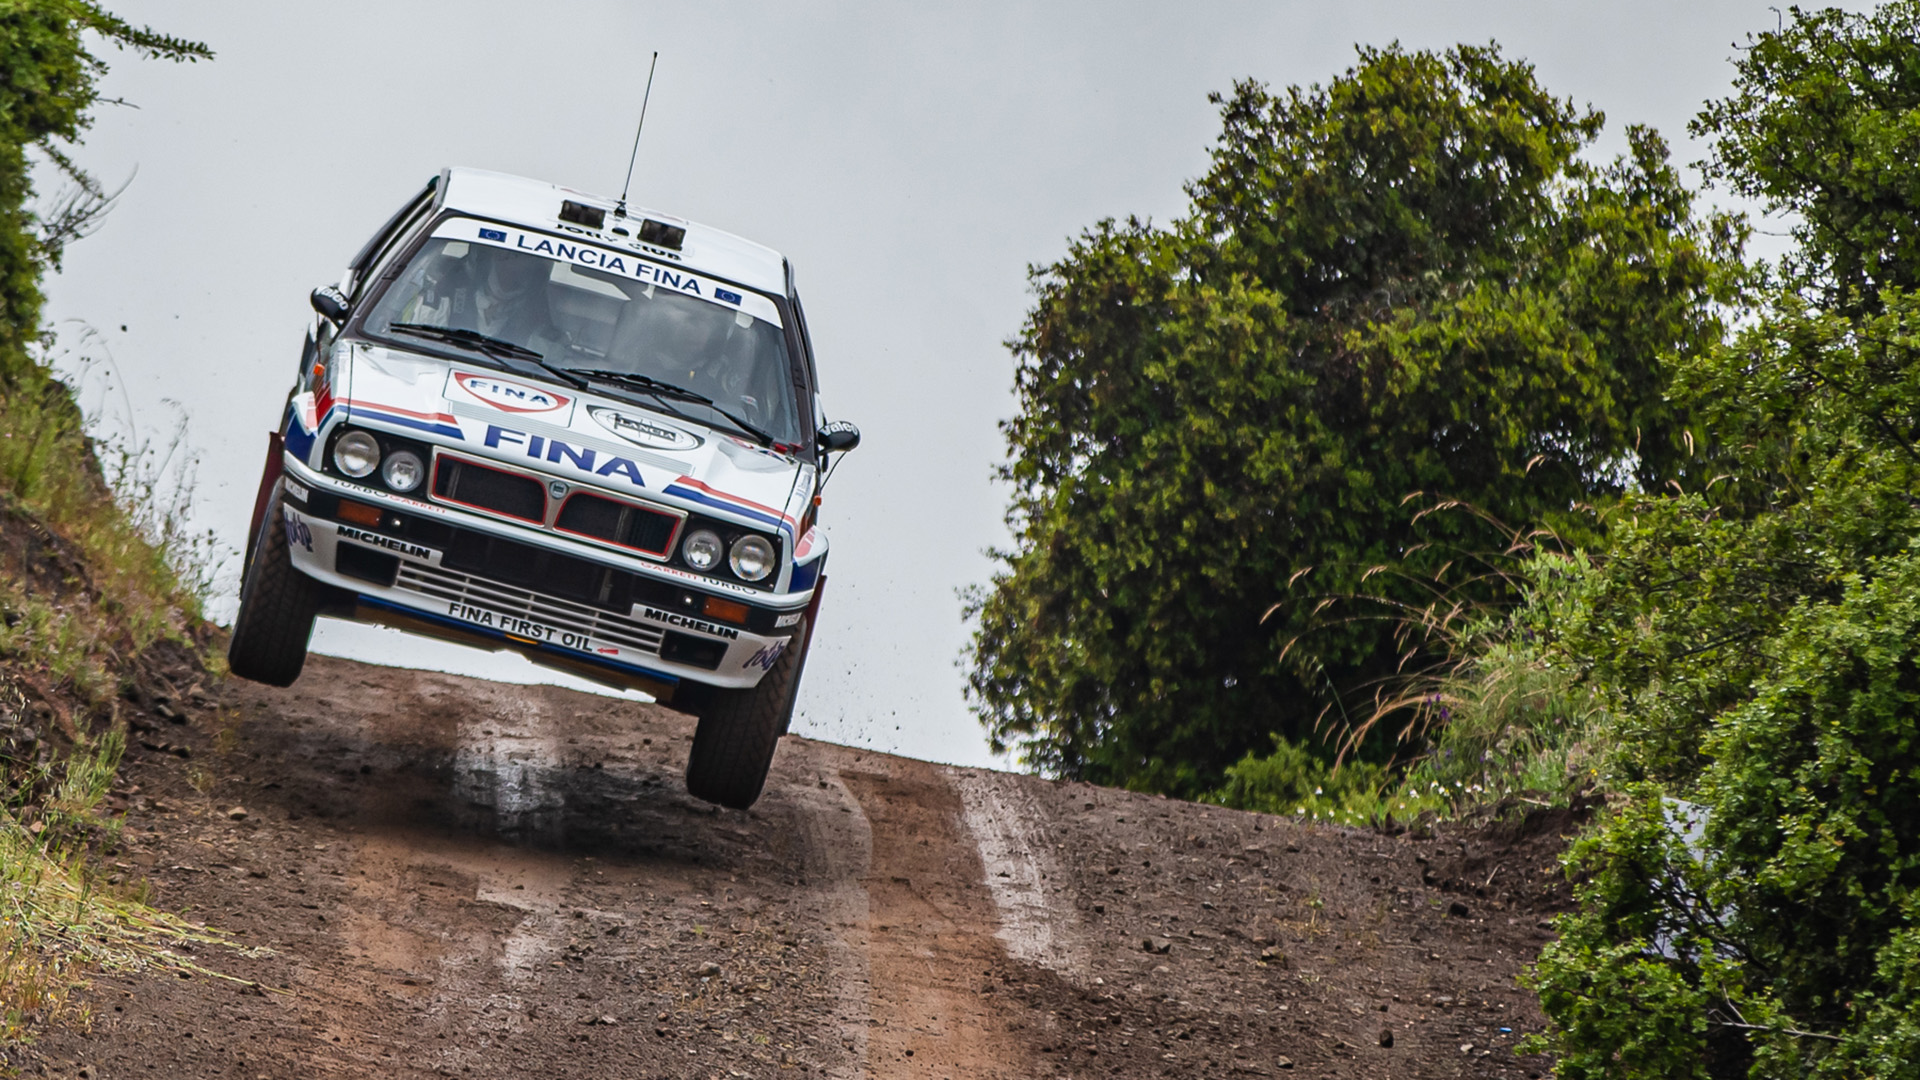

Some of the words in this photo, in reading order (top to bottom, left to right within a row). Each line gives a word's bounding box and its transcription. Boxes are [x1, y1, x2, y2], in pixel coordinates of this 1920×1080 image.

[517, 234, 627, 274] LANCIA
[635, 263, 702, 295] FINA
[469, 379, 550, 406] FINA
[619, 418, 675, 440] LANCIA
[484, 424, 646, 488] FINA
[336, 525, 431, 560] MICHELIN
[448, 602, 493, 626] FINA
[499, 615, 557, 643] FIRST
[561, 632, 593, 653] OIL
[643, 607, 739, 640] MICHELIN
